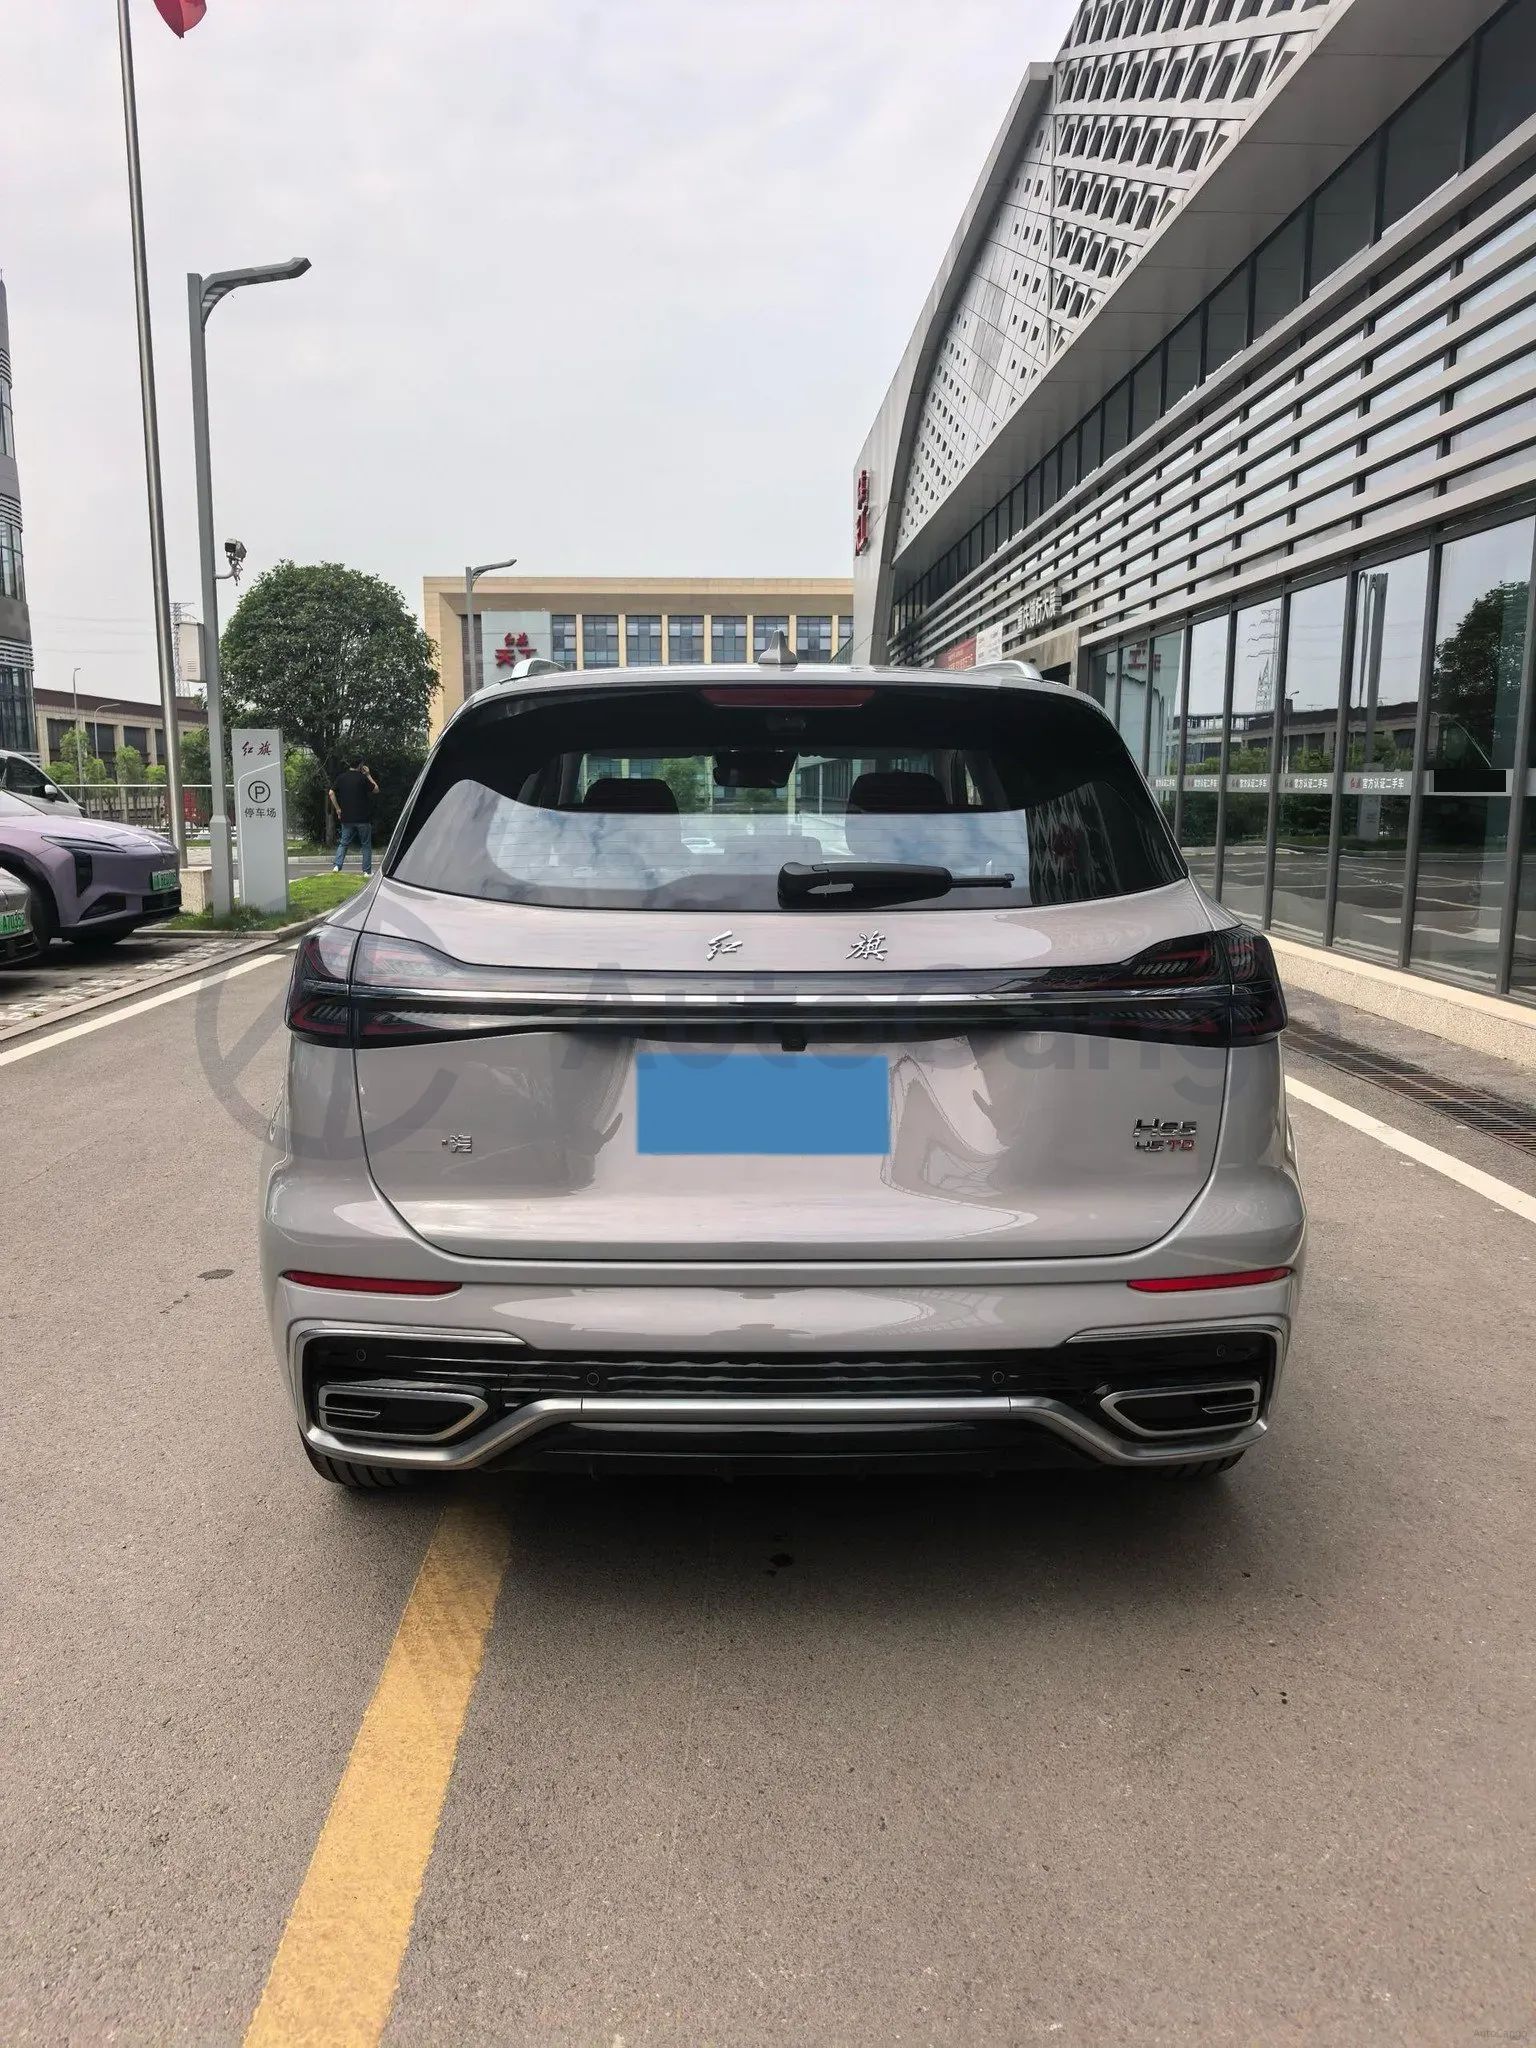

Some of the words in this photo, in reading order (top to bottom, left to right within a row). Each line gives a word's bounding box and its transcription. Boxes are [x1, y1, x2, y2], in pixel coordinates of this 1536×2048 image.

[242, 741, 272, 756] 红旗
[1362, 777, 1404, 789] 官方认证二手车
[244, 807, 277, 818] 停车场
[708, 930, 888, 961] 红旗
